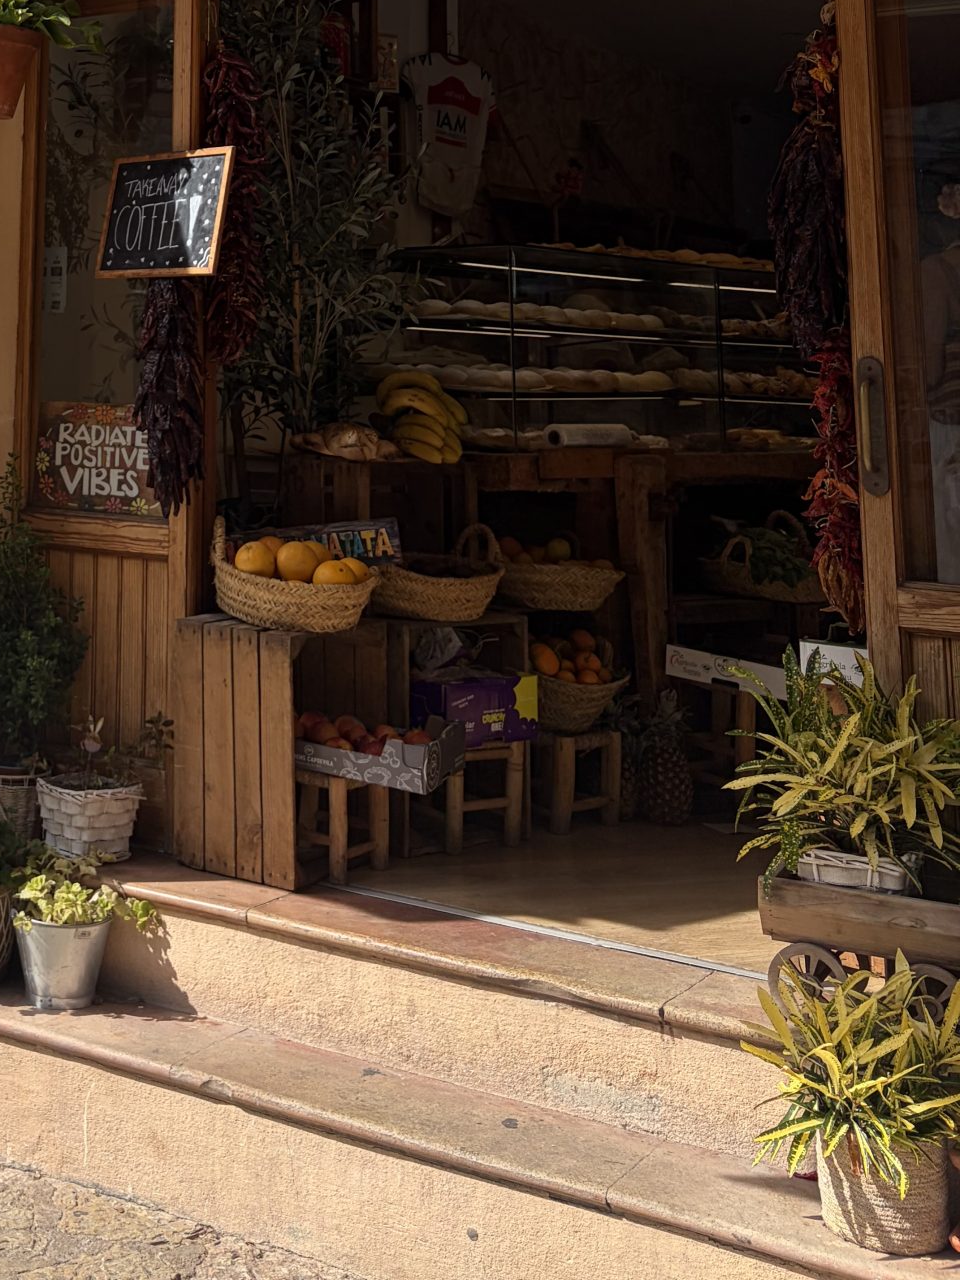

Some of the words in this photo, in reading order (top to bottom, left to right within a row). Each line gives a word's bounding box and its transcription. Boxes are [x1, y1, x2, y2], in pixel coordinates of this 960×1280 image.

[58, 422, 149, 448] RADIATE
[55, 441, 150, 471] POSITIVE
[59, 465, 140, 499] VIBES
